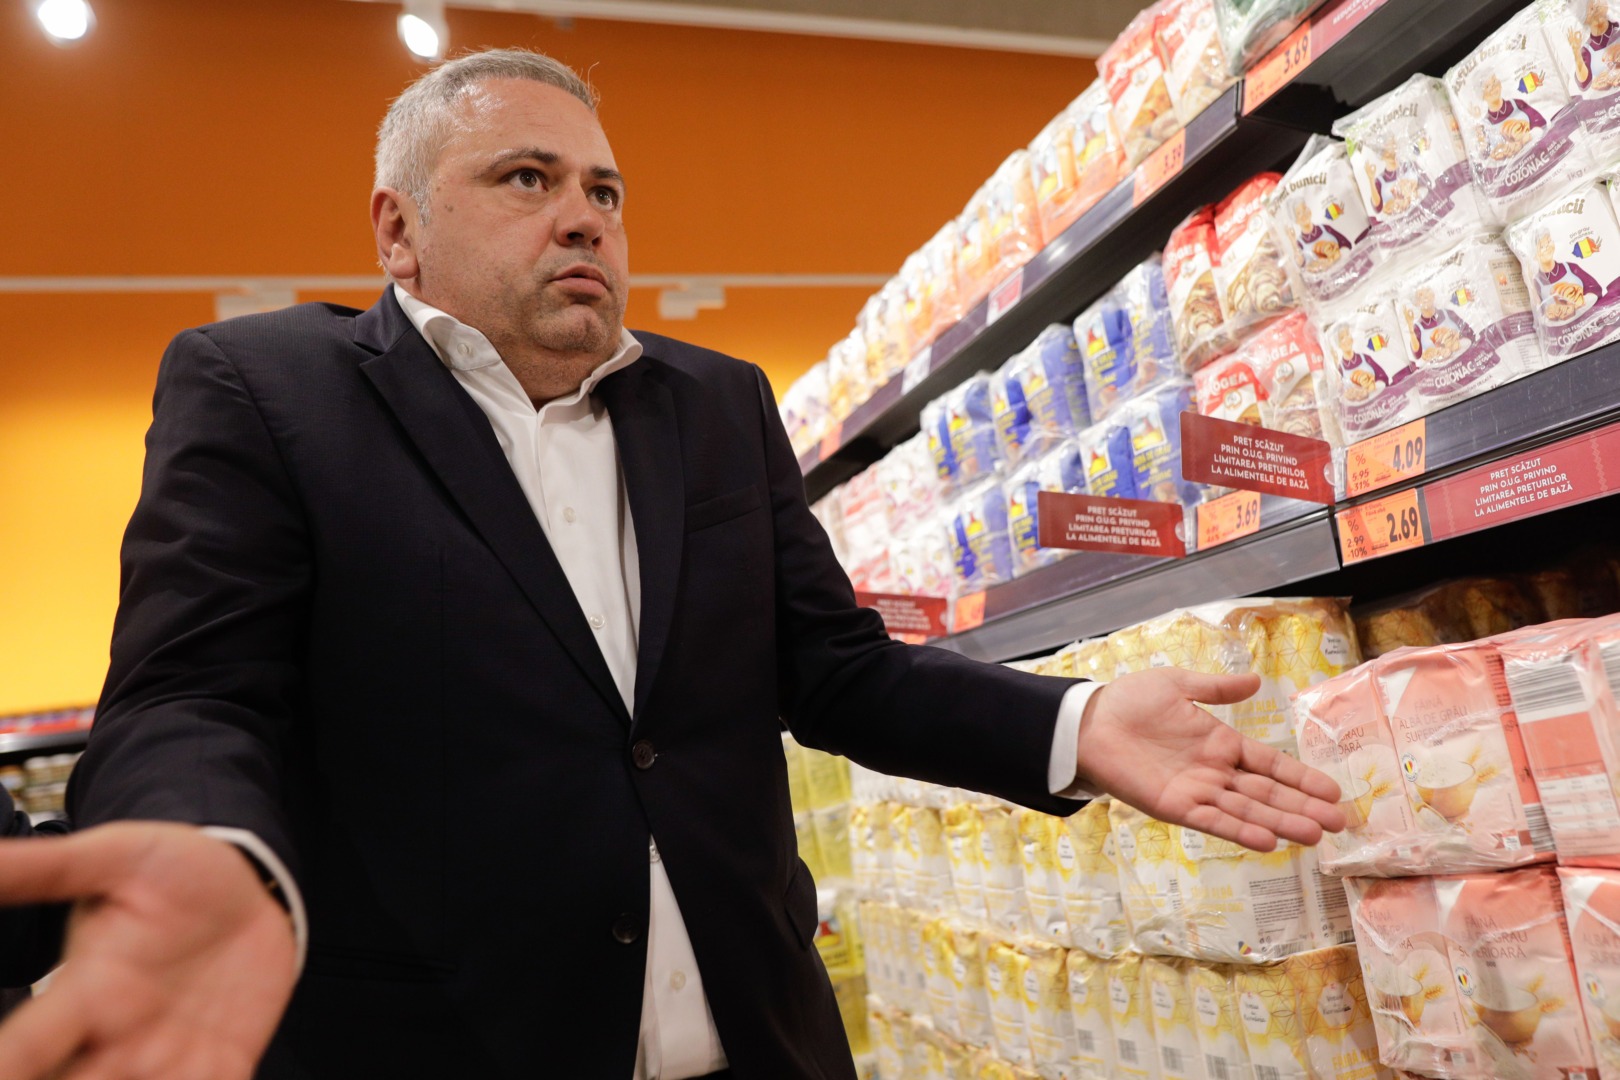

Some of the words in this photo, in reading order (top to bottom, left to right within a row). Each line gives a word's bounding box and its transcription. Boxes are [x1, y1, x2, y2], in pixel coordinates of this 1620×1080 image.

[1284, 35, 1308, 74] 3.69
[1505, 151, 1550, 187] COZONAC
[1434, 361, 1475, 388] COZONAC
[1221, 444, 1240, 455] PRIN
[1243, 449, 1265, 460] O.U.G.
[1266, 453, 1298, 466] PRIVIND
[1233, 435, 1252, 447] PREȚ
[1255, 439, 1284, 452] SCĂZUT
[1393, 436, 1423, 472] 4.09
[1211, 464, 1222, 474] LA
[1224, 466, 1274, 484] ALIMENTELE
[1277, 477, 1287, 486] DE
[1289, 478, 1309, 490] BAZĂ
[1214, 454, 1256, 469] LIMITAREA
[1258, 462, 1305, 479] PREȚURILOR
[1352, 468, 1370, 481] 5.95
[1490, 468, 1509, 480] PREȚ
[1511, 457, 1541, 474] SCĂZUT
[1475, 490, 1515, 507] LIMITAREA
[1517, 473, 1567, 493] PREȚURILOR
[1480, 483, 1498, 494] PRIN
[1500, 476, 1522, 488] O.U.G.
[1523, 465, 1557, 482] PRIVIND
[1474, 508, 1485, 517] LA
[1486, 494, 1535, 514] ALIMENTELE
[1537, 490, 1549, 500] DE
[1550, 481, 1573, 496] BAZĂ
[1075, 514, 1094, 523] PRIN
[1118, 517, 1150, 528] PRIVIND
[1235, 499, 1258, 529] 3.69
[1348, 518, 1360, 533] %
[1387, 506, 1418, 543] 2.69
[1066, 532, 1076, 541] LA
[1078, 533, 1126, 545] ALIMENTELE
[1129, 537, 1139, 546] DE
[1068, 523, 1109, 534] LIMITAREA
[1347, 535, 1365, 548] 2.99
[1424, 712, 1438, 725] DE
